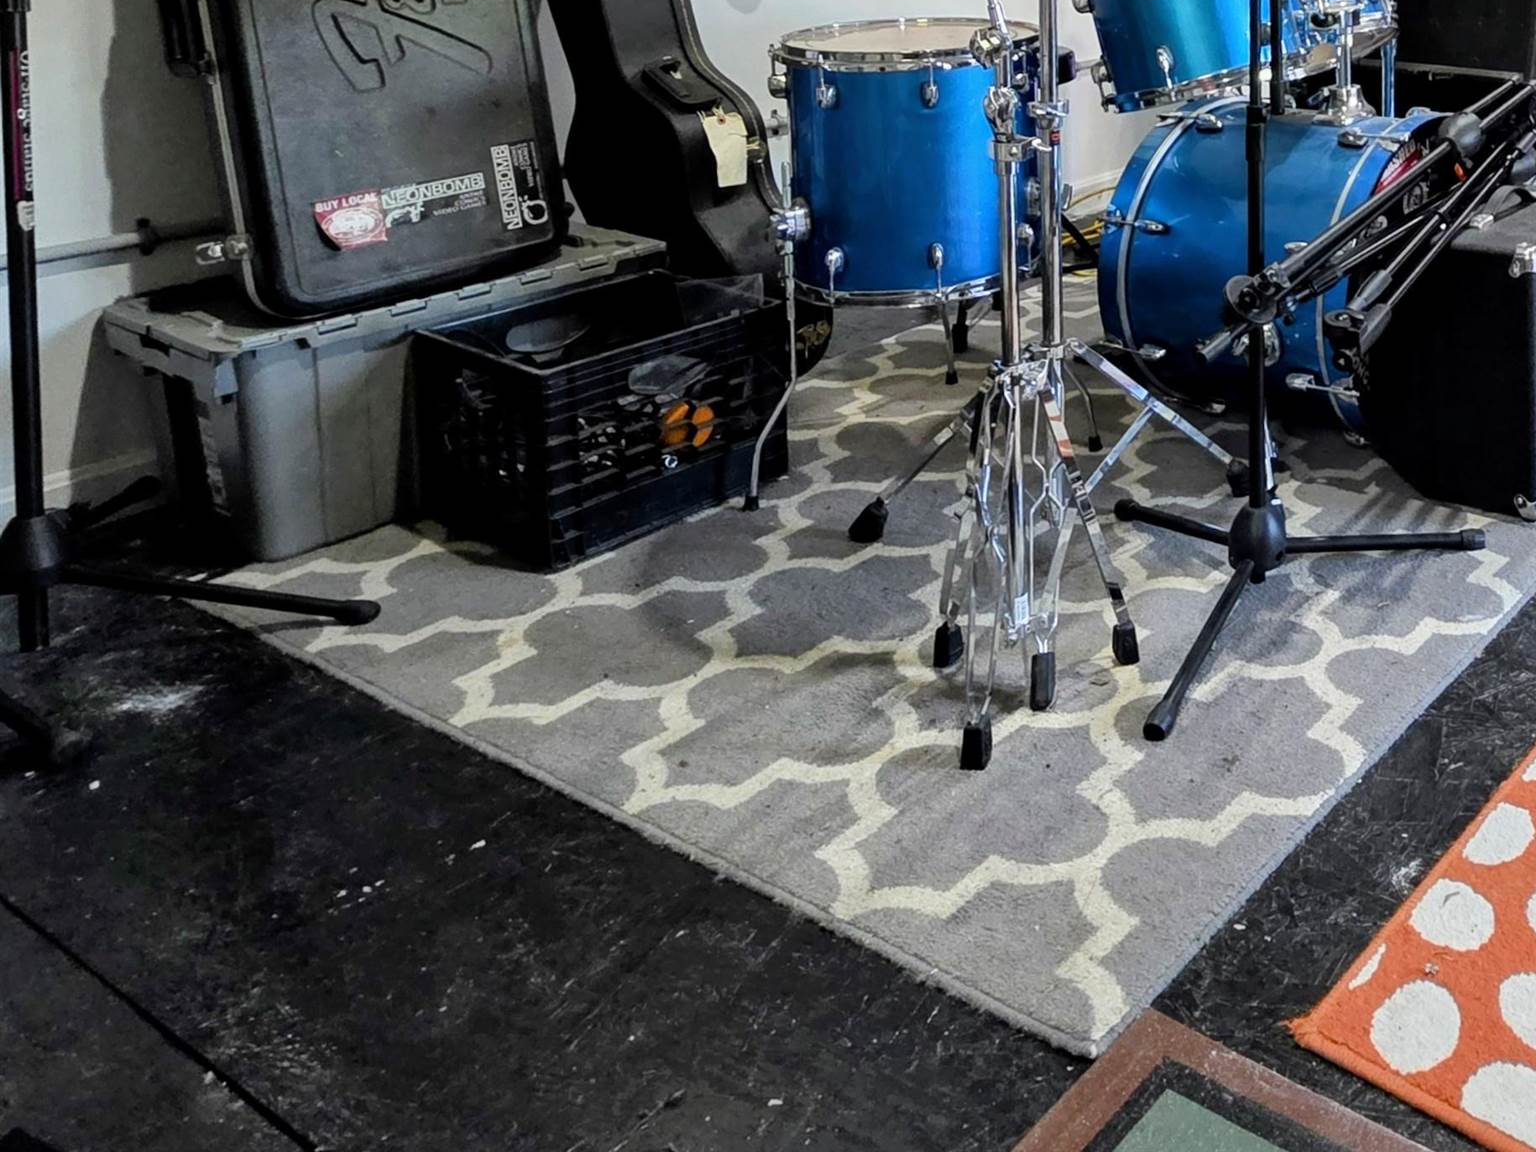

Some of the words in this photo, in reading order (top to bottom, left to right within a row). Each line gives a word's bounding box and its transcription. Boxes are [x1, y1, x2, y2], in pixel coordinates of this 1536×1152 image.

[381, 173, 485, 209] NEONBOMB
[491, 145, 522, 229] NEONBOMB
[314, 199, 340, 212] BUY
